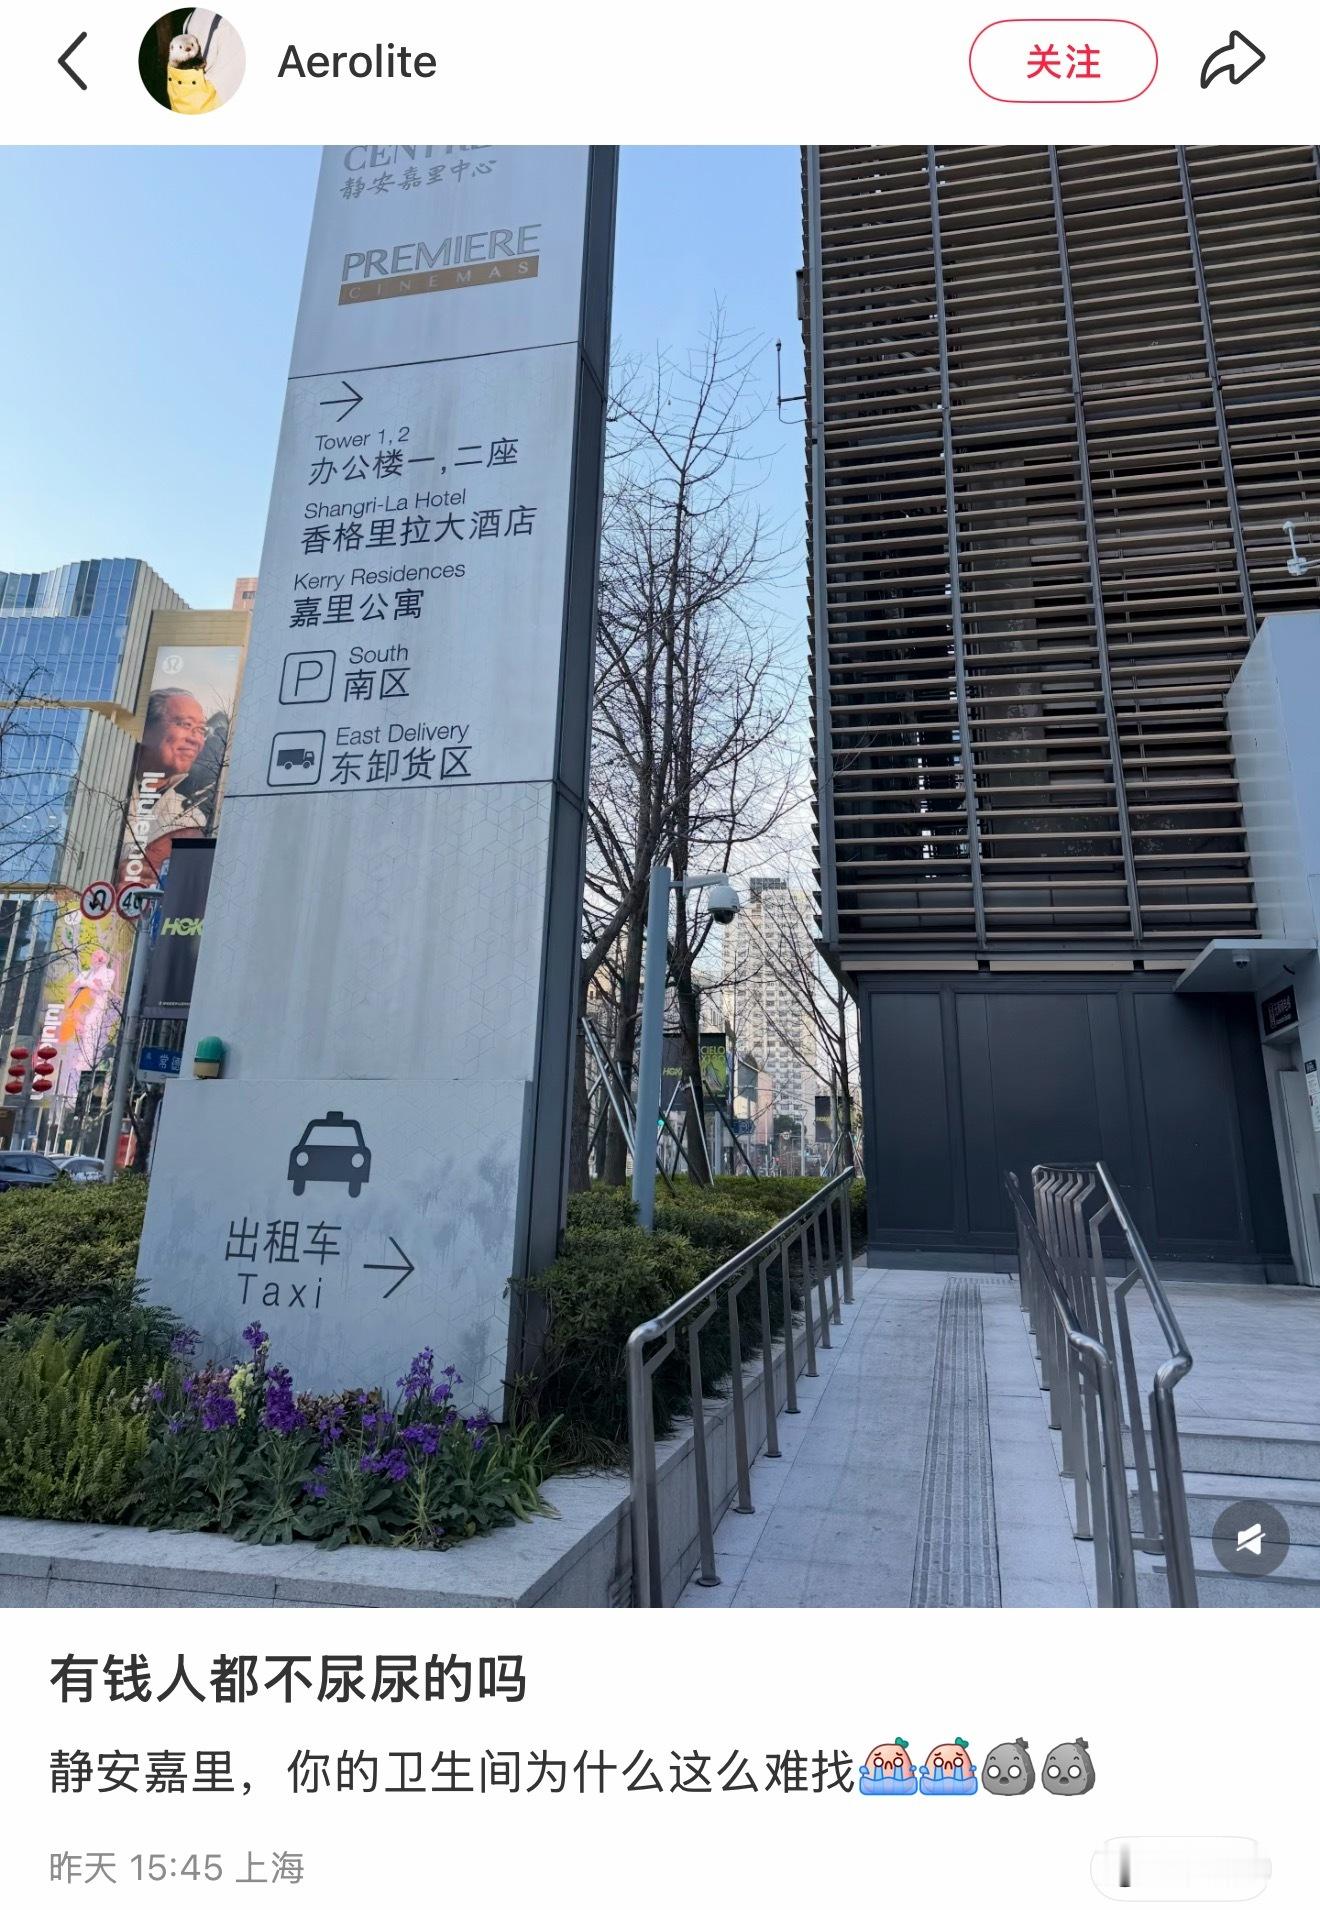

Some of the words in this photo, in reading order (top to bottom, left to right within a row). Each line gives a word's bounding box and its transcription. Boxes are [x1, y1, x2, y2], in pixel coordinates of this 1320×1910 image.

[344, 145, 493, 171] CEN
[340, 159, 497, 200] 静安嘉里中心
[341, 223, 542, 282] PREMIERE
[349, 261, 529, 299] CINEMAS
[314, 433, 371, 452] Tower
[304, 495, 408, 519] Shangri-La
[415, 487, 467, 509] Hotel
[301, 505, 538, 556] 香格里拉大酒店
[294, 573, 345, 591] Kerry
[351, 563, 466, 586] Residences
[289, 588, 424, 628] 嘉里公寓
[349, 643, 408, 664] South
[343, 668, 411, 702] 南区
[336, 726, 381, 746] East
[388, 722, 470, 743] Delivery
[330, 745, 473, 785] 东卸货区
[700, 1045, 726, 1055] CIELO
[225, 1216, 342, 1265] 出租车
[237, 1273, 322, 1309] Taxi
